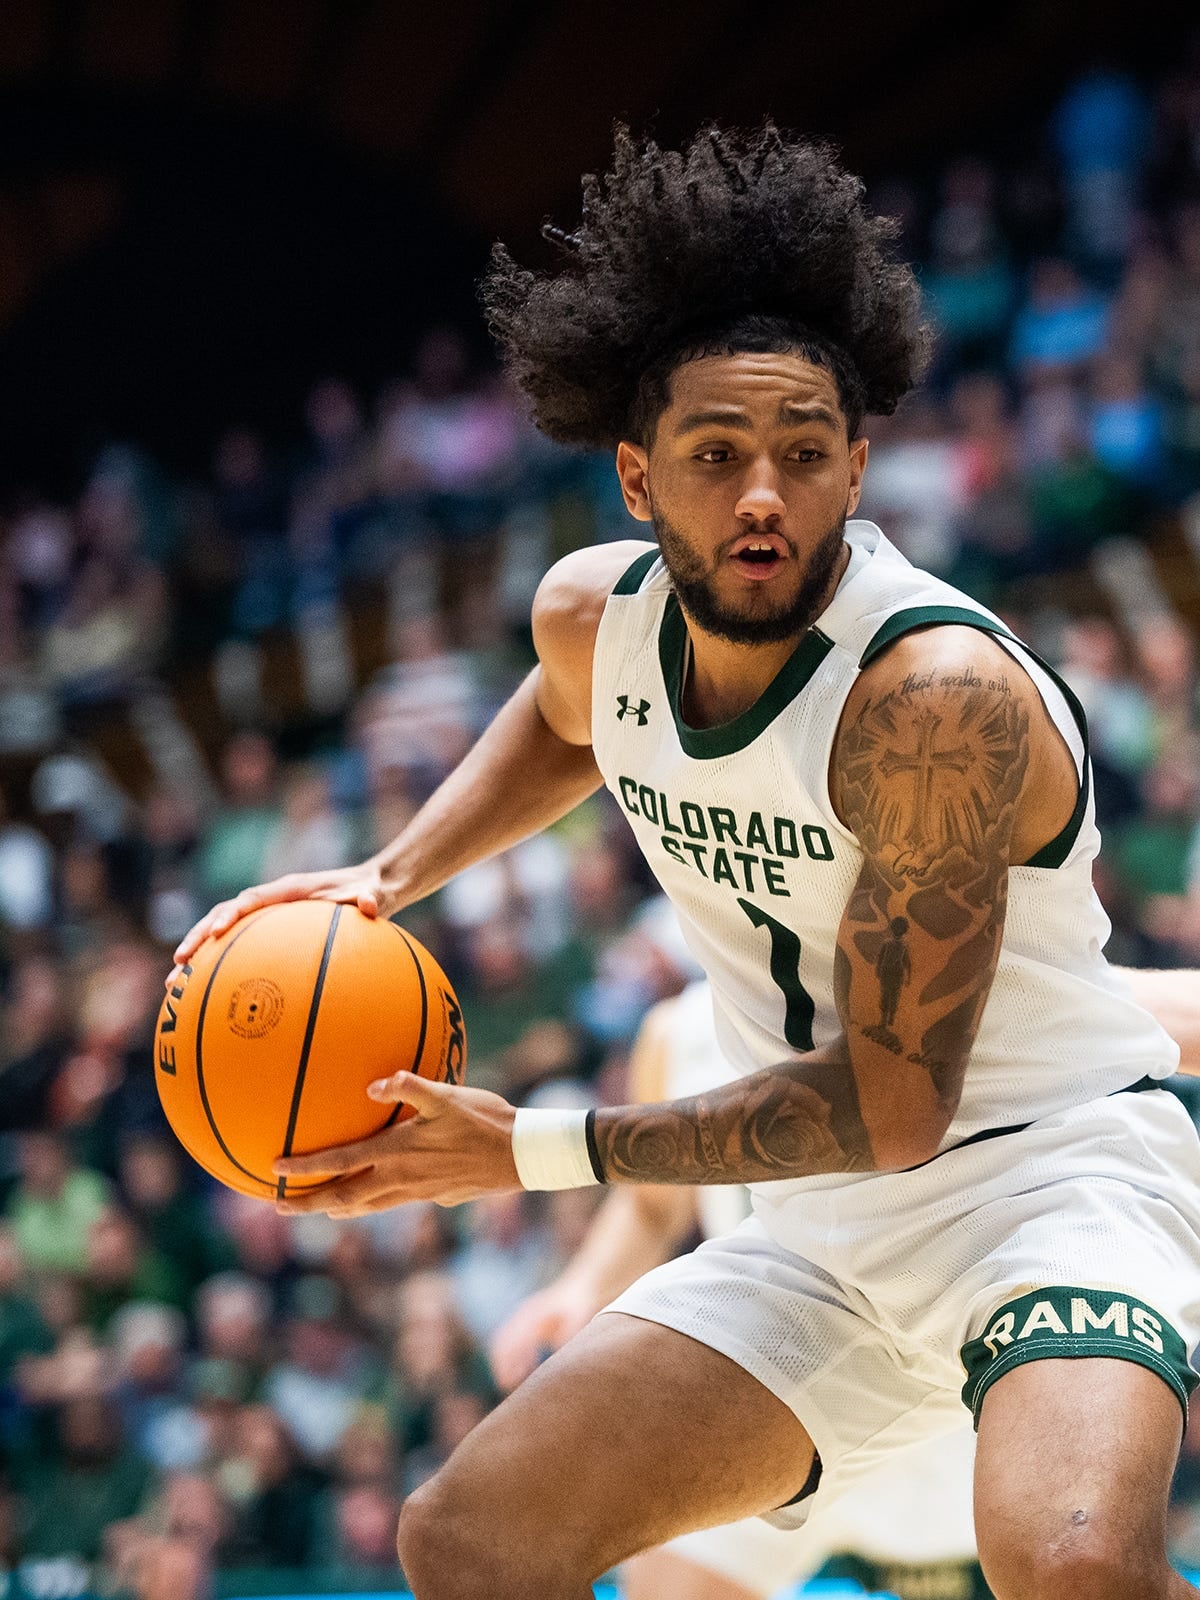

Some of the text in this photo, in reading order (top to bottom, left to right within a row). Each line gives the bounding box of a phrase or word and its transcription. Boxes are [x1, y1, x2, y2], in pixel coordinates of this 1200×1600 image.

[618, 775, 835, 862] COLORADO
[660, 835, 792, 898] STATE
[893, 849, 937, 878] God
[735, 896, 817, 1054] 1
[983, 1297, 1164, 1360] RAMS
